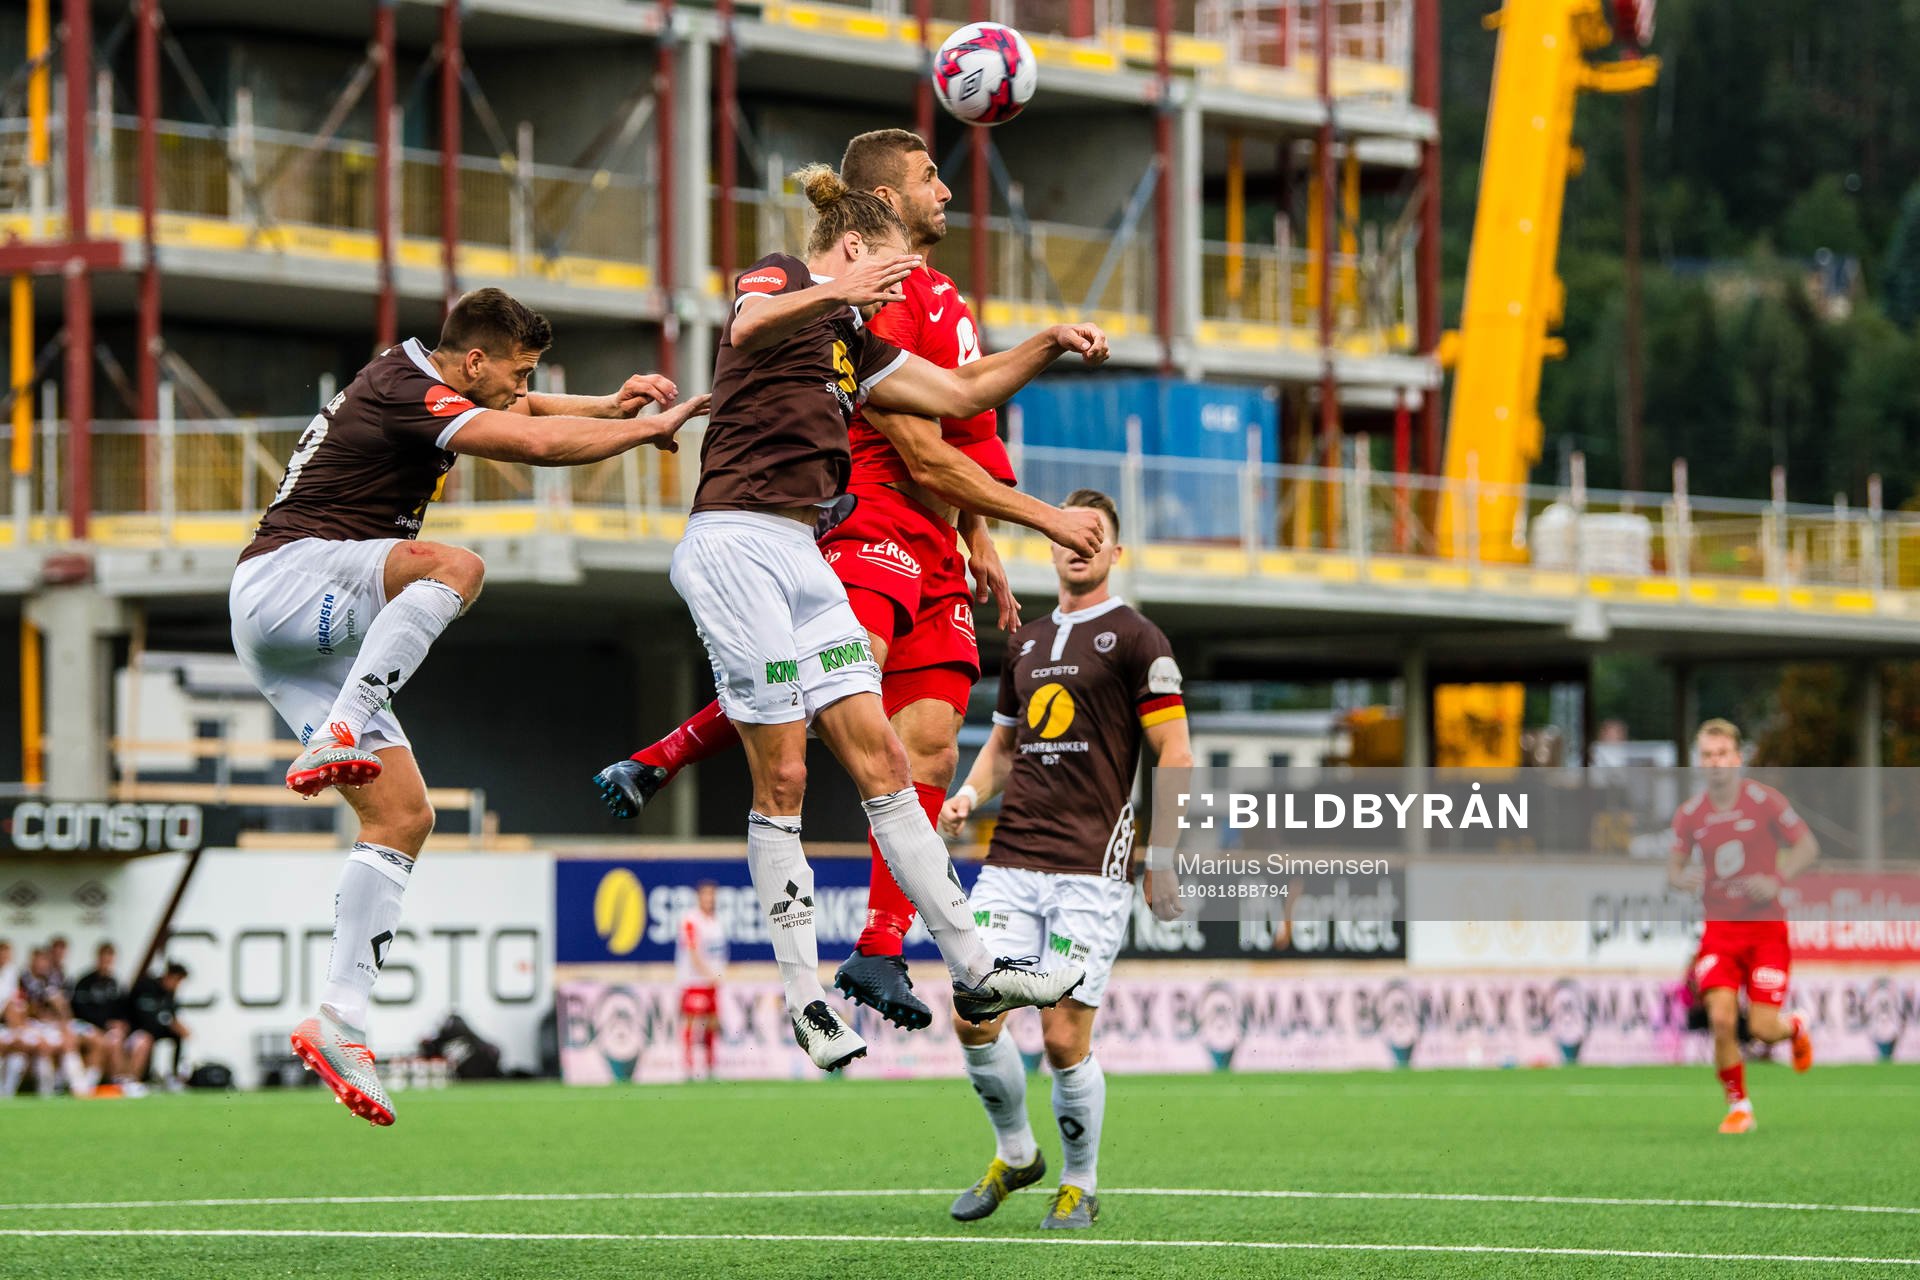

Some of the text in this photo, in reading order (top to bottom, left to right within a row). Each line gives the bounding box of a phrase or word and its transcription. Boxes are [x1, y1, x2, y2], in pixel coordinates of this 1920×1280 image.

[318, 593, 335, 647] ISACHSEN
[819, 641, 868, 673] KIWI
[357, 683, 385, 706] MITSUB
[791, 691, 798, 706] 2
